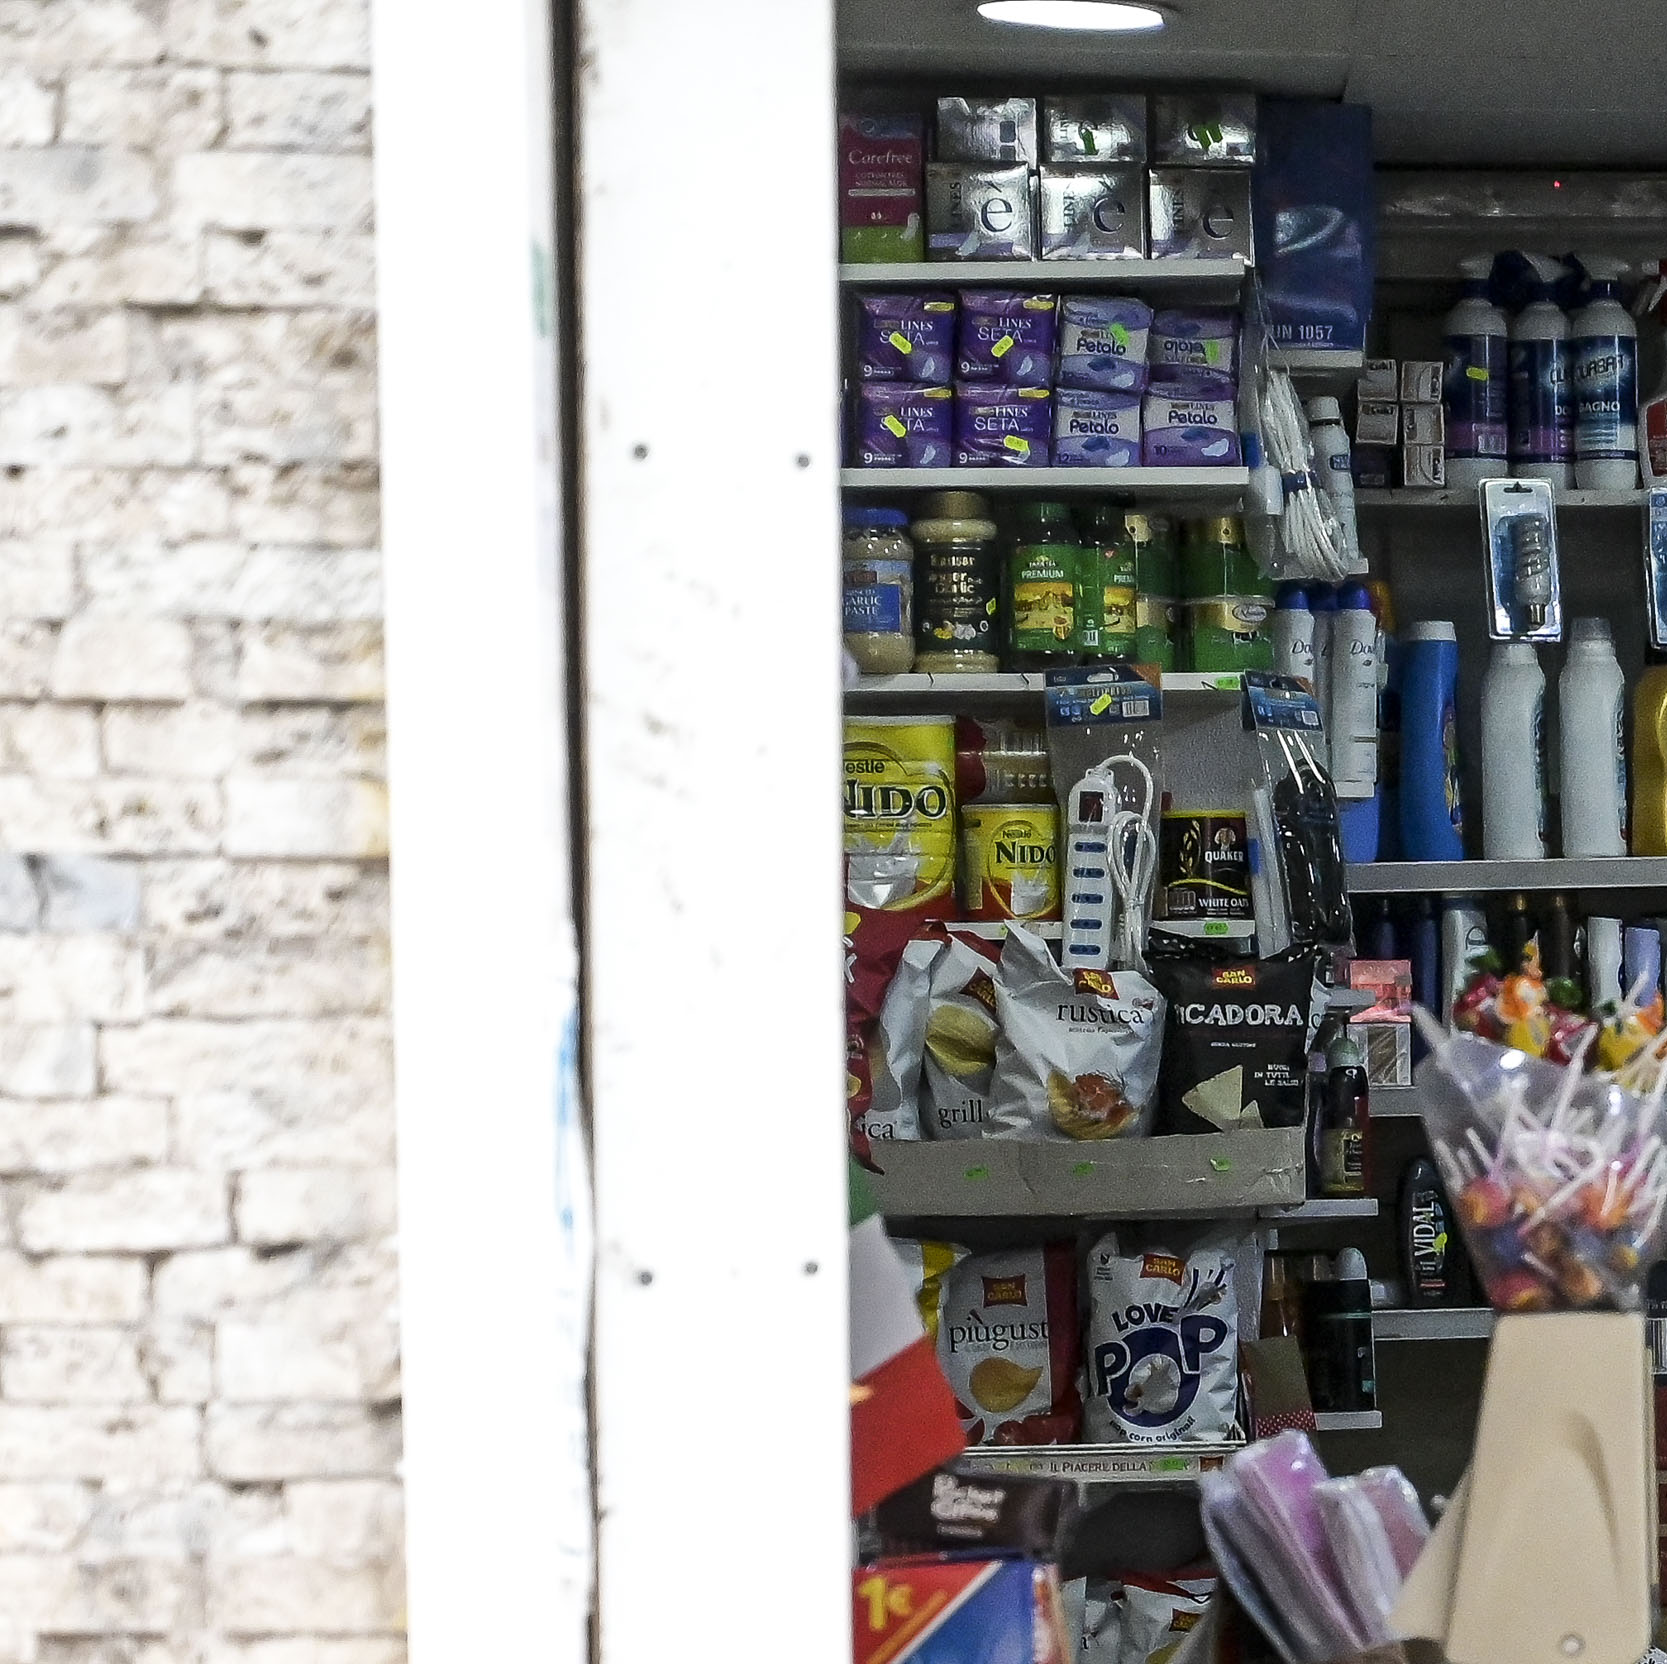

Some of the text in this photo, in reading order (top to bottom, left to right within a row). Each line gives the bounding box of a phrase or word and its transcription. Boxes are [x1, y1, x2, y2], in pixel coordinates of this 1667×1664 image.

[848, 149, 913, 166] Carefree
[900, 319, 933, 332] LINES
[999, 317, 1032, 330] LINES
[1296, 322, 1334, 341] 1057
[1076, 338, 1127, 356] Petalo
[900, 406, 933, 419] LINES
[1168, 408, 1218, 425] Petalo
[974, 415, 1021, 432] SETA
[1069, 418, 1120, 436] Petalo
[1020, 568, 1065, 581] PREMIUM
[993, 842, 1057, 866] NIDO
[1203, 850, 1245, 864] QUAKER
[1198, 898, 1228, 911] WHITE
[1221, 968, 1246, 978] SAN
[1215, 976, 1254, 986] CARLO
[1055, 998, 1145, 1025] rustica
[1146, 1264, 1184, 1277] CARLO
[1111, 1302, 1177, 1333] LOVE
[1095, 1314, 1229, 1428] POP
[1127, 1432, 1154, 1443] corn
[1049, 1460, 1147, 1473] IL PIACERE DELLA
